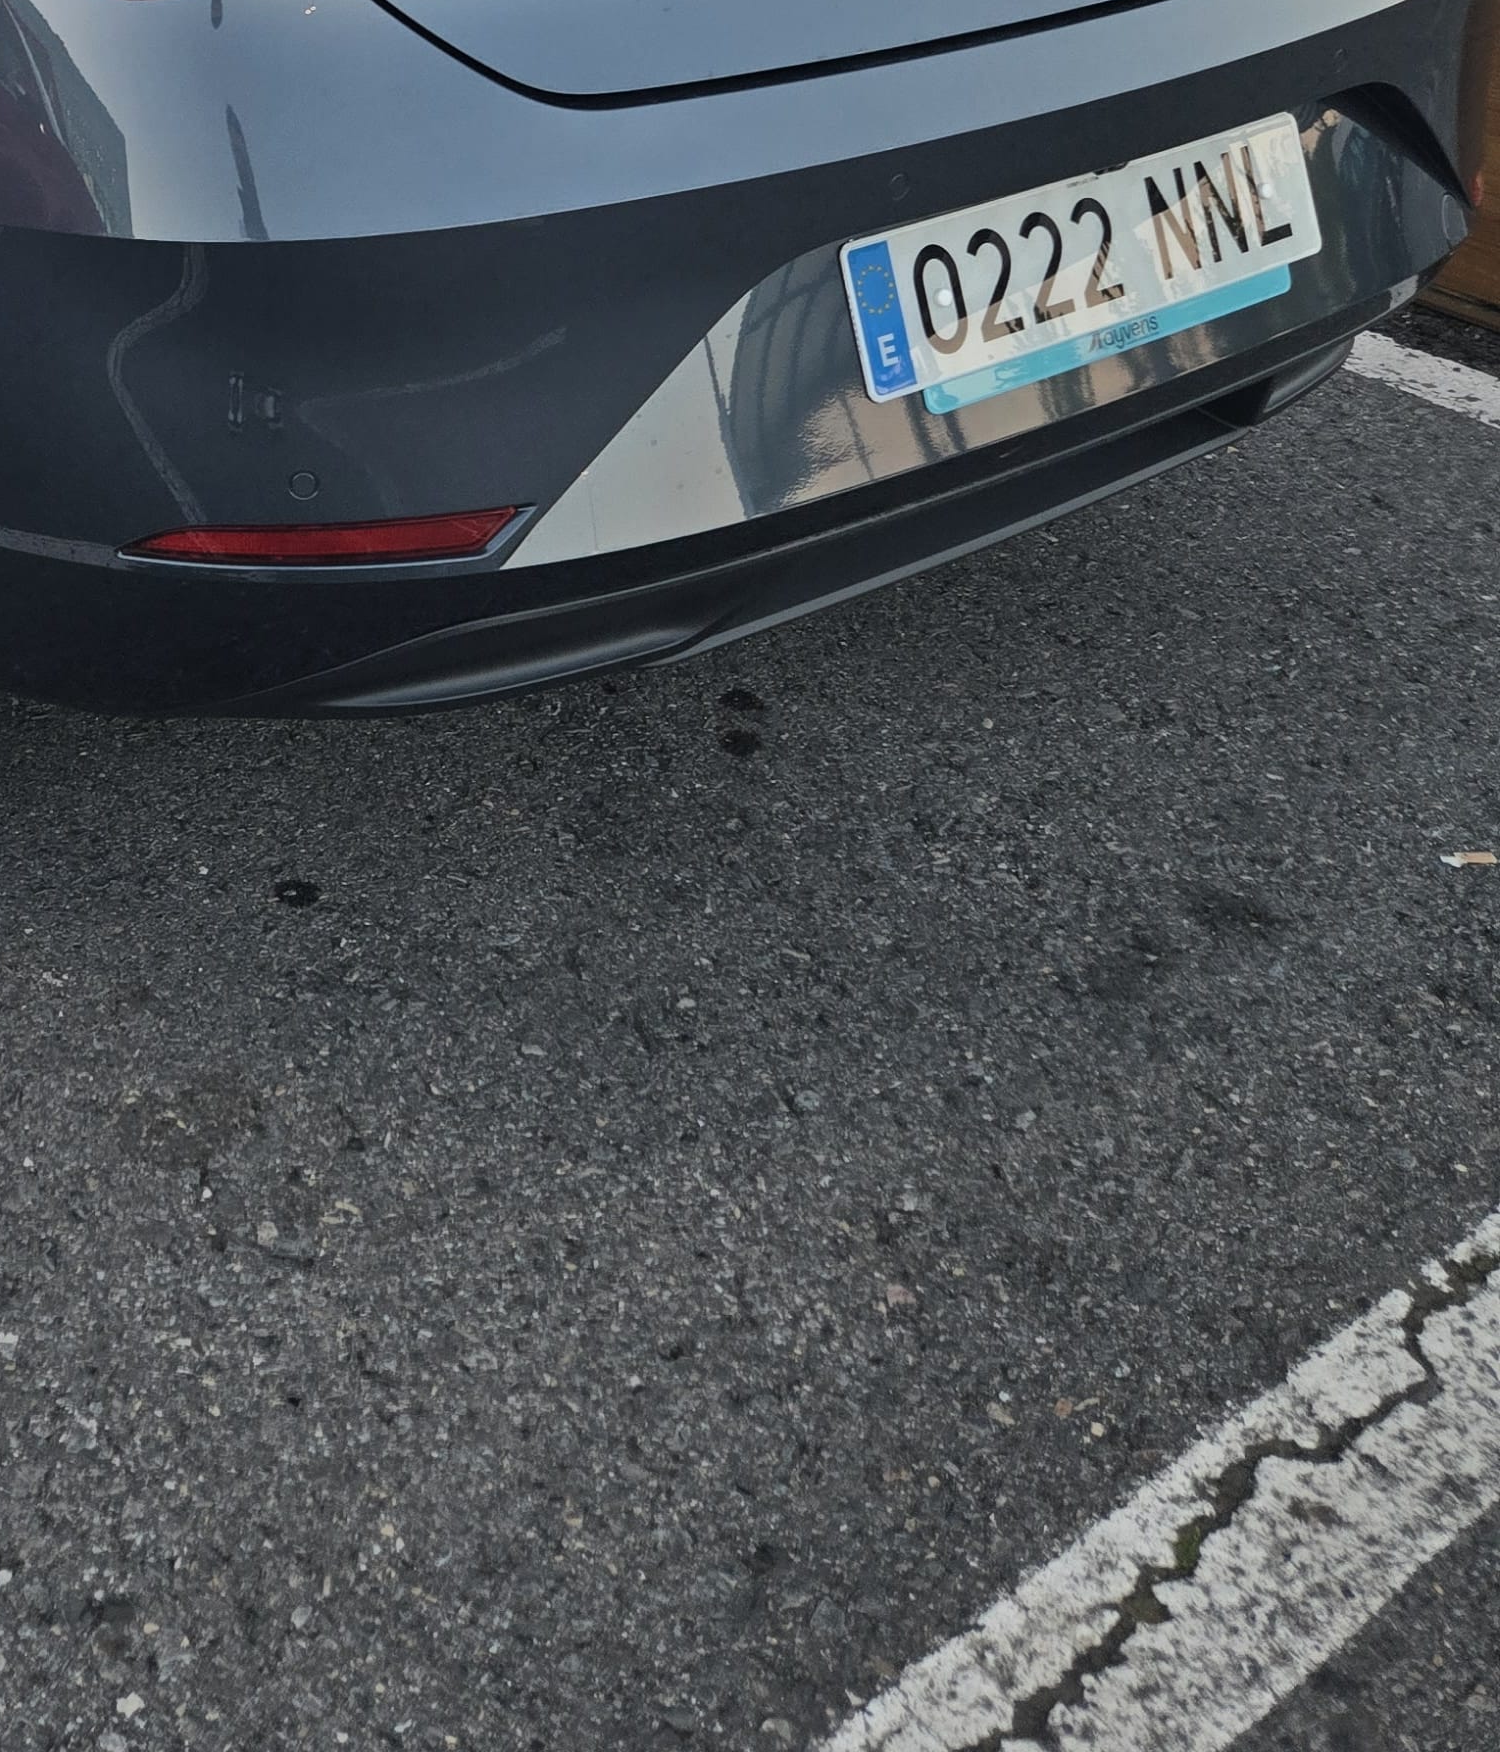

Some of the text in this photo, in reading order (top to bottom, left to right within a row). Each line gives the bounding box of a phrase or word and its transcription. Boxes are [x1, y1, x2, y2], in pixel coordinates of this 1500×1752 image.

[913, 145, 1293, 355] 0222 NNL
[877, 333, 899, 367] E
